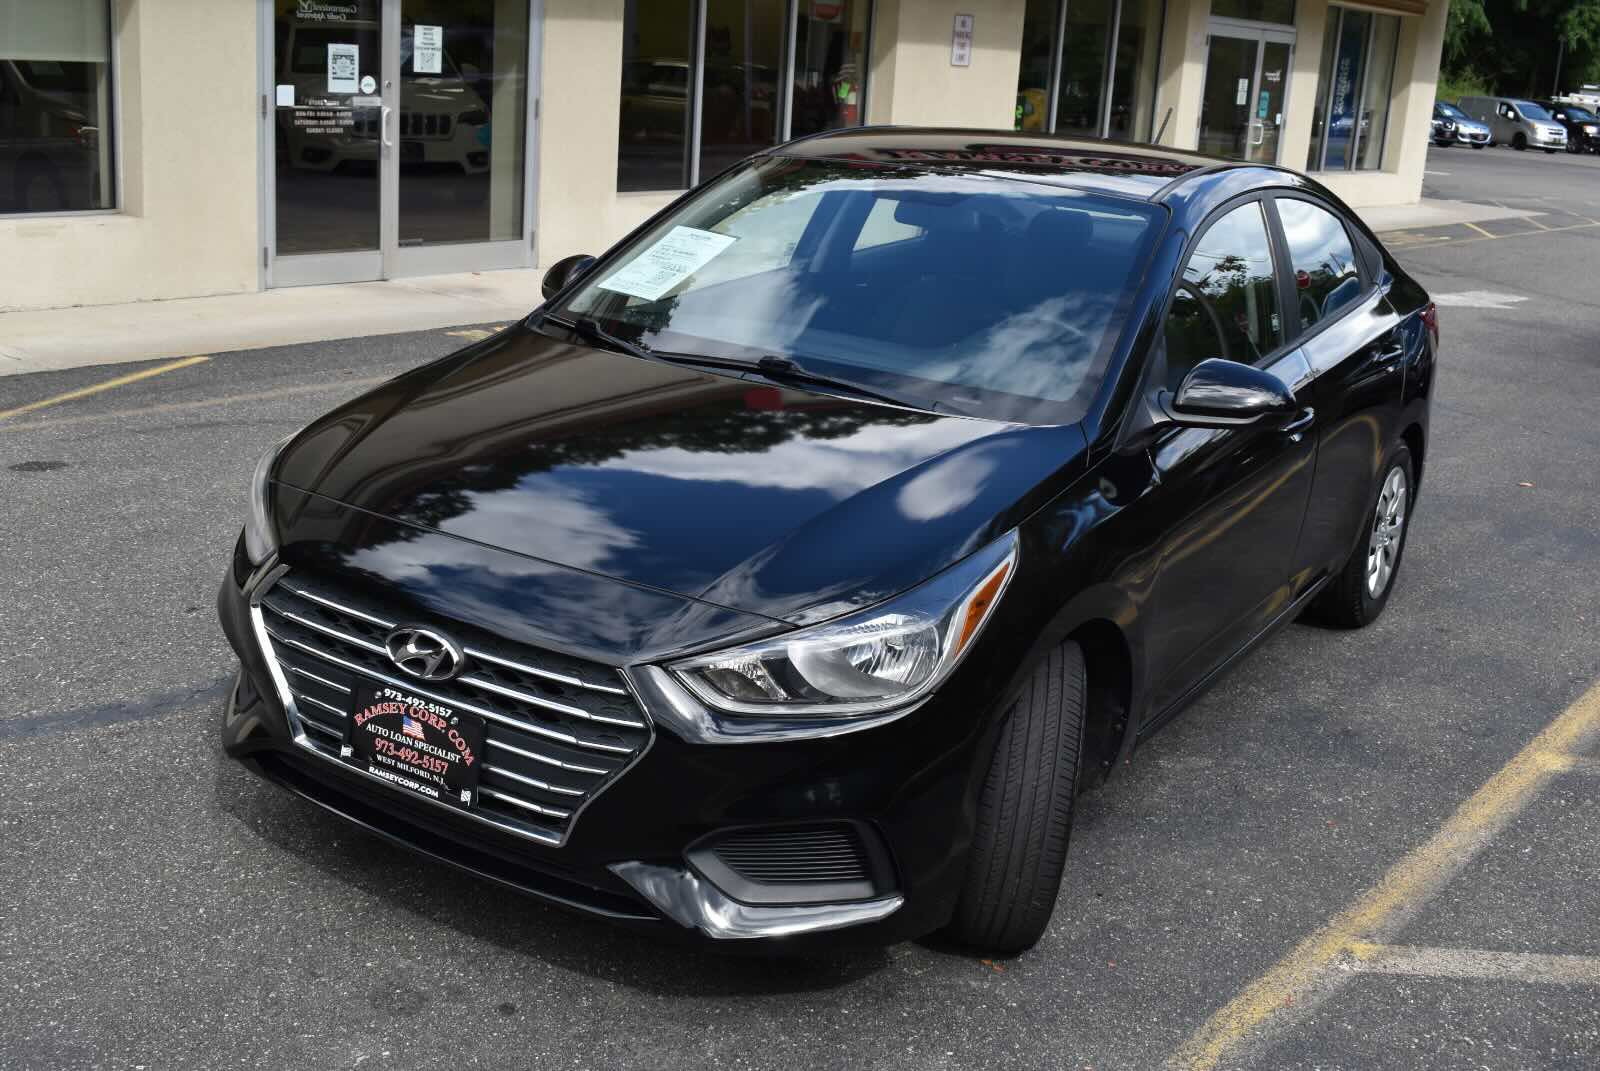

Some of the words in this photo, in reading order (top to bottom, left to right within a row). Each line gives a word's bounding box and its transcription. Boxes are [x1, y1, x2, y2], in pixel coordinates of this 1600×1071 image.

[354, 702, 408, 727] RAMSEY
[384, 688, 452, 717] 973-492-5157
[366, 723, 389, 737] AUTO
[390, 731, 413, 746] LOAN
[414, 740, 461, 763] SPECIALIST
[375, 738, 449, 775] 973-492-5157
[376, 754, 396, 767] WEST
[368, 766, 439, 798] RAMSEYCORP.COM
